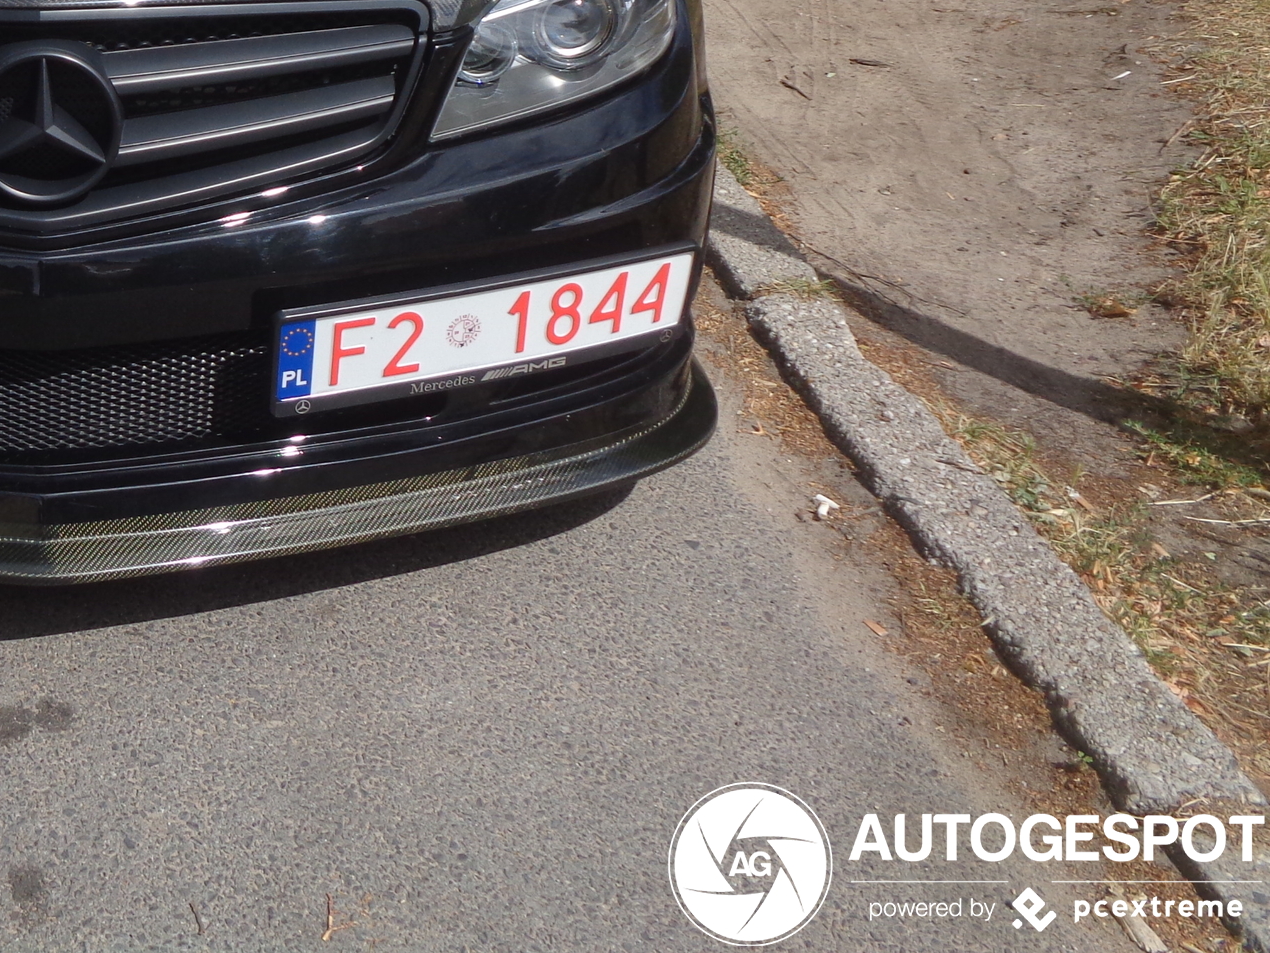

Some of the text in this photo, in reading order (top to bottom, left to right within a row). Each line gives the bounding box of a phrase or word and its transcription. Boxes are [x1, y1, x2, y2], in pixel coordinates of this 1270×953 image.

[330, 311, 424, 386] F2
[508, 262, 671, 353] 1844
[282, 369, 307, 388] PL
[410, 357, 567, 394] Mercedes AMG
